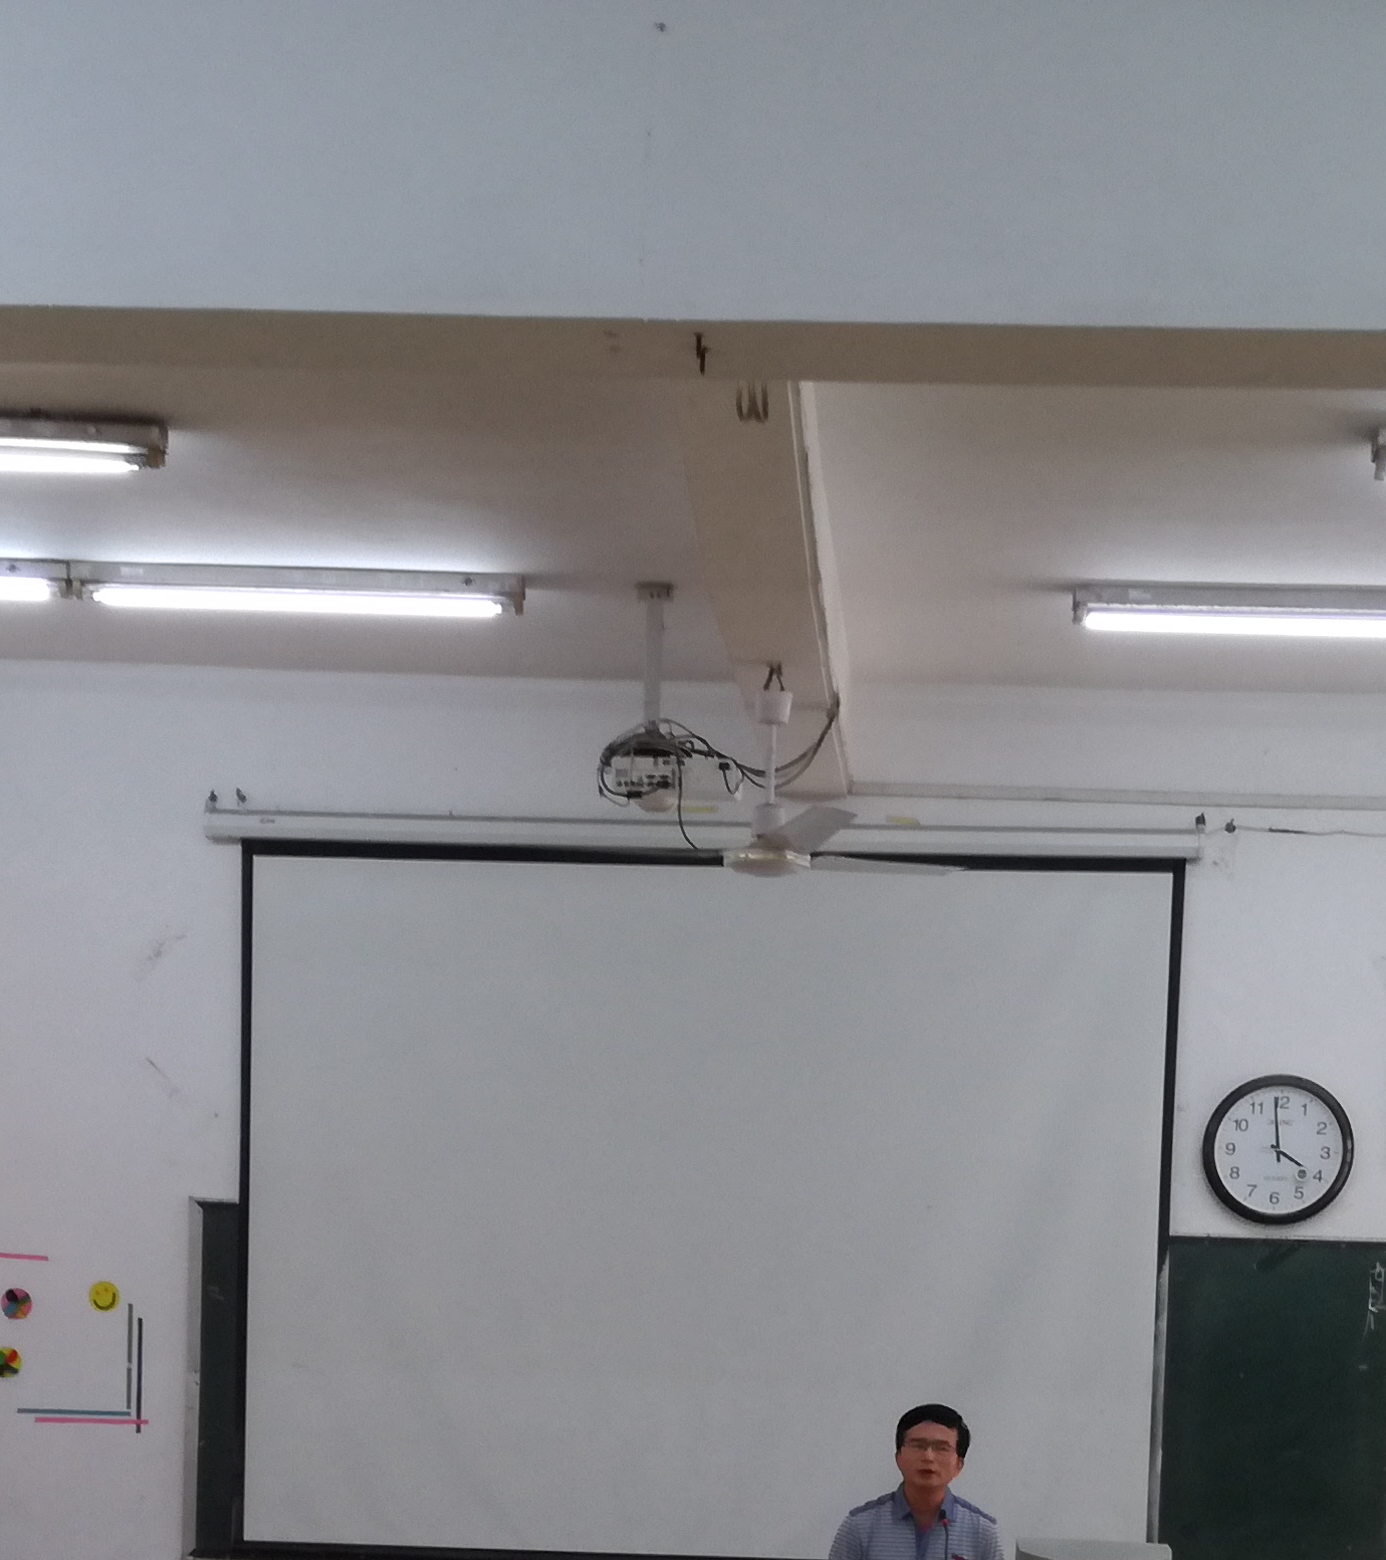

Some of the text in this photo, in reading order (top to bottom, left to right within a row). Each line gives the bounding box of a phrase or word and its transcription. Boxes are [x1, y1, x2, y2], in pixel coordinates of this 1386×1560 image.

[1250, 1102, 1263, 1115] 11
[1234, 1118, 1249, 1132] 10
[1316, 1122, 1327, 1135] 2
[1225, 1142, 1236, 1155] 9
[1320, 1146, 1331, 1160] 3
[1229, 1167, 1240, 1180] 8
[1313, 1170, 1323, 1183] 4
[1247, 1185, 1257, 1197] 7
[1293, 1187, 1304, 1199] 5
[1269, 1192, 1280, 1205] 6
